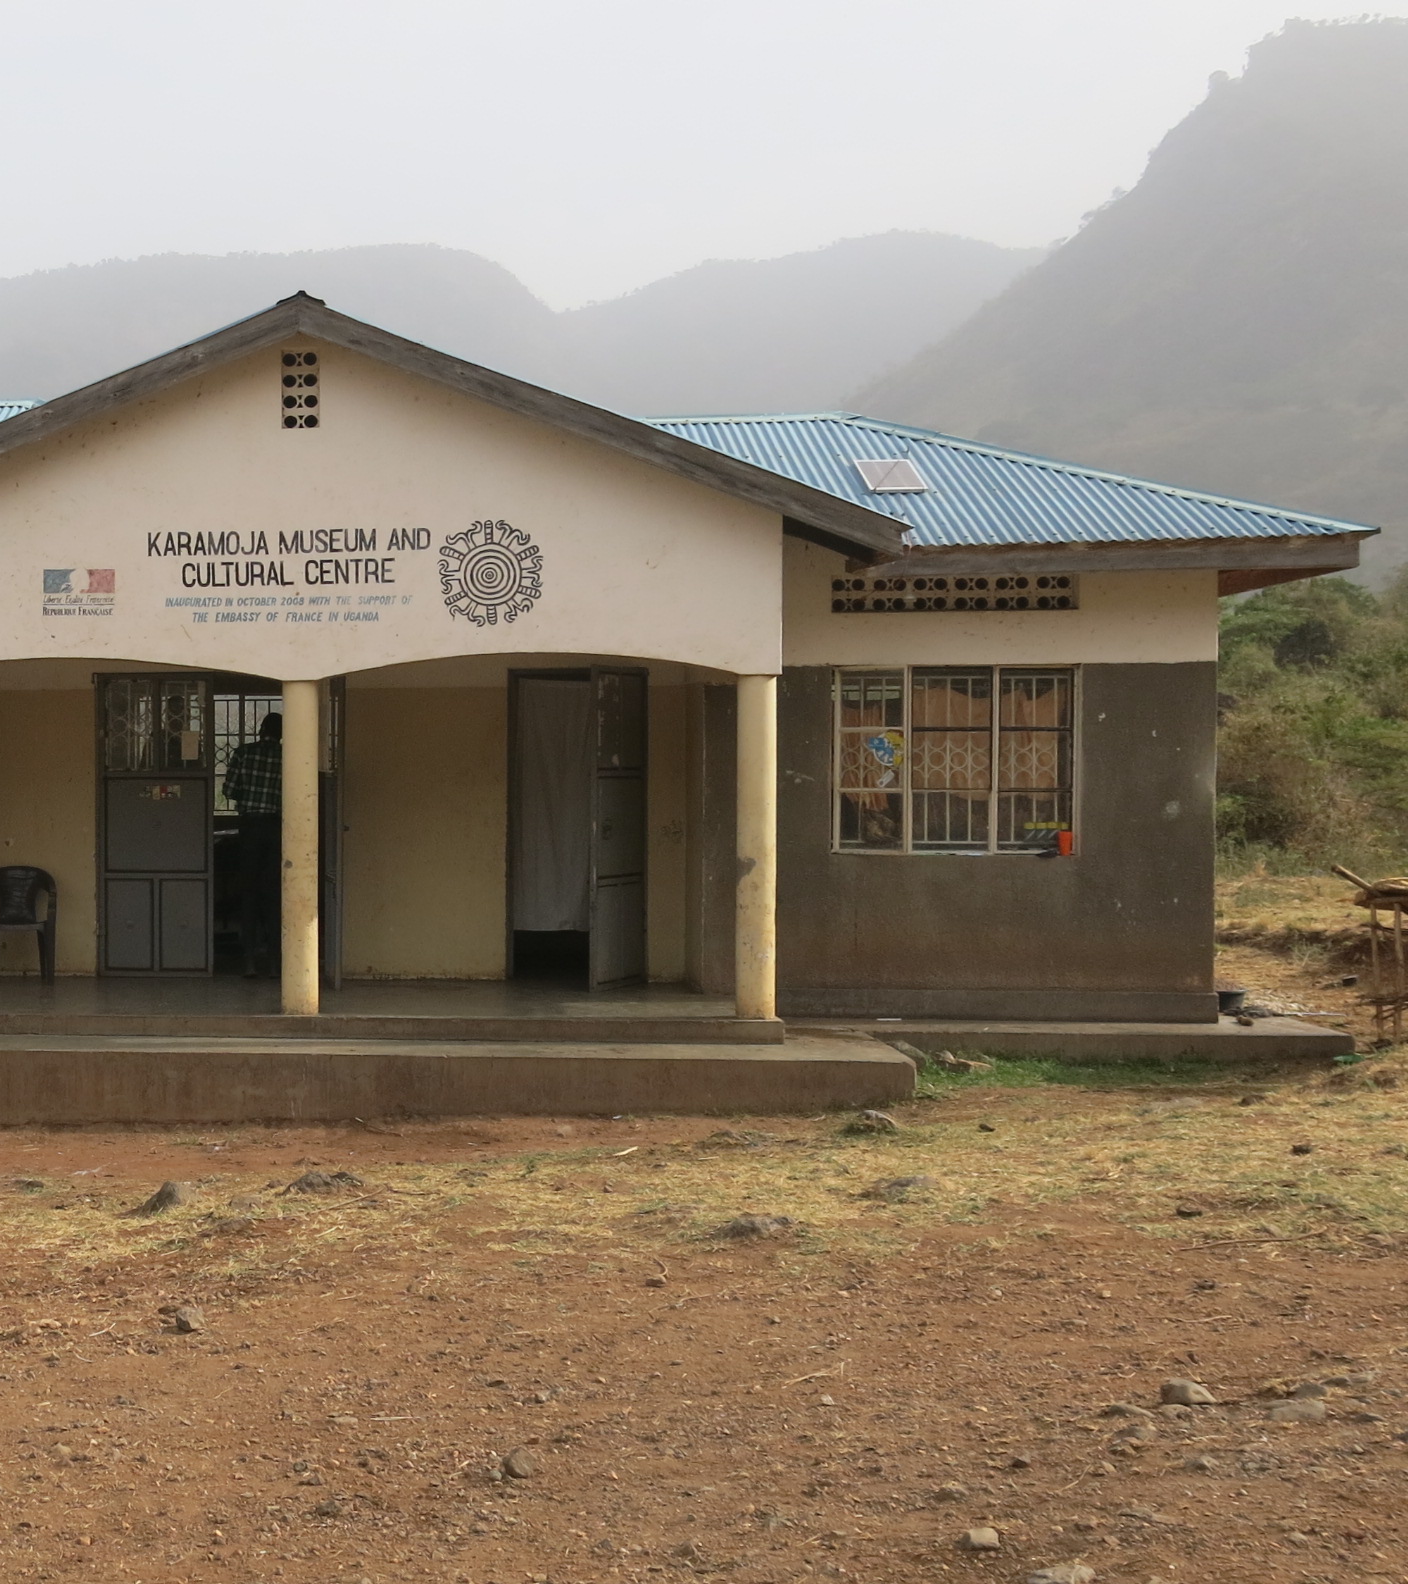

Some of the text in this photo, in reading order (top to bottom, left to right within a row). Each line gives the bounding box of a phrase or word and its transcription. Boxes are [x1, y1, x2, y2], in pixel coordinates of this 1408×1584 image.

[147, 527, 431, 557] KARAMOJA MUSEUM AND
[182, 557, 396, 588] CULTURAL CENTRE
[165, 594, 413, 608] INAUGURATED IN OCTOBER 2008 WITH THE SUPPORT OF
[192, 610, 380, 623] THE EMBASSY OF FRANCE IN UGANDA
